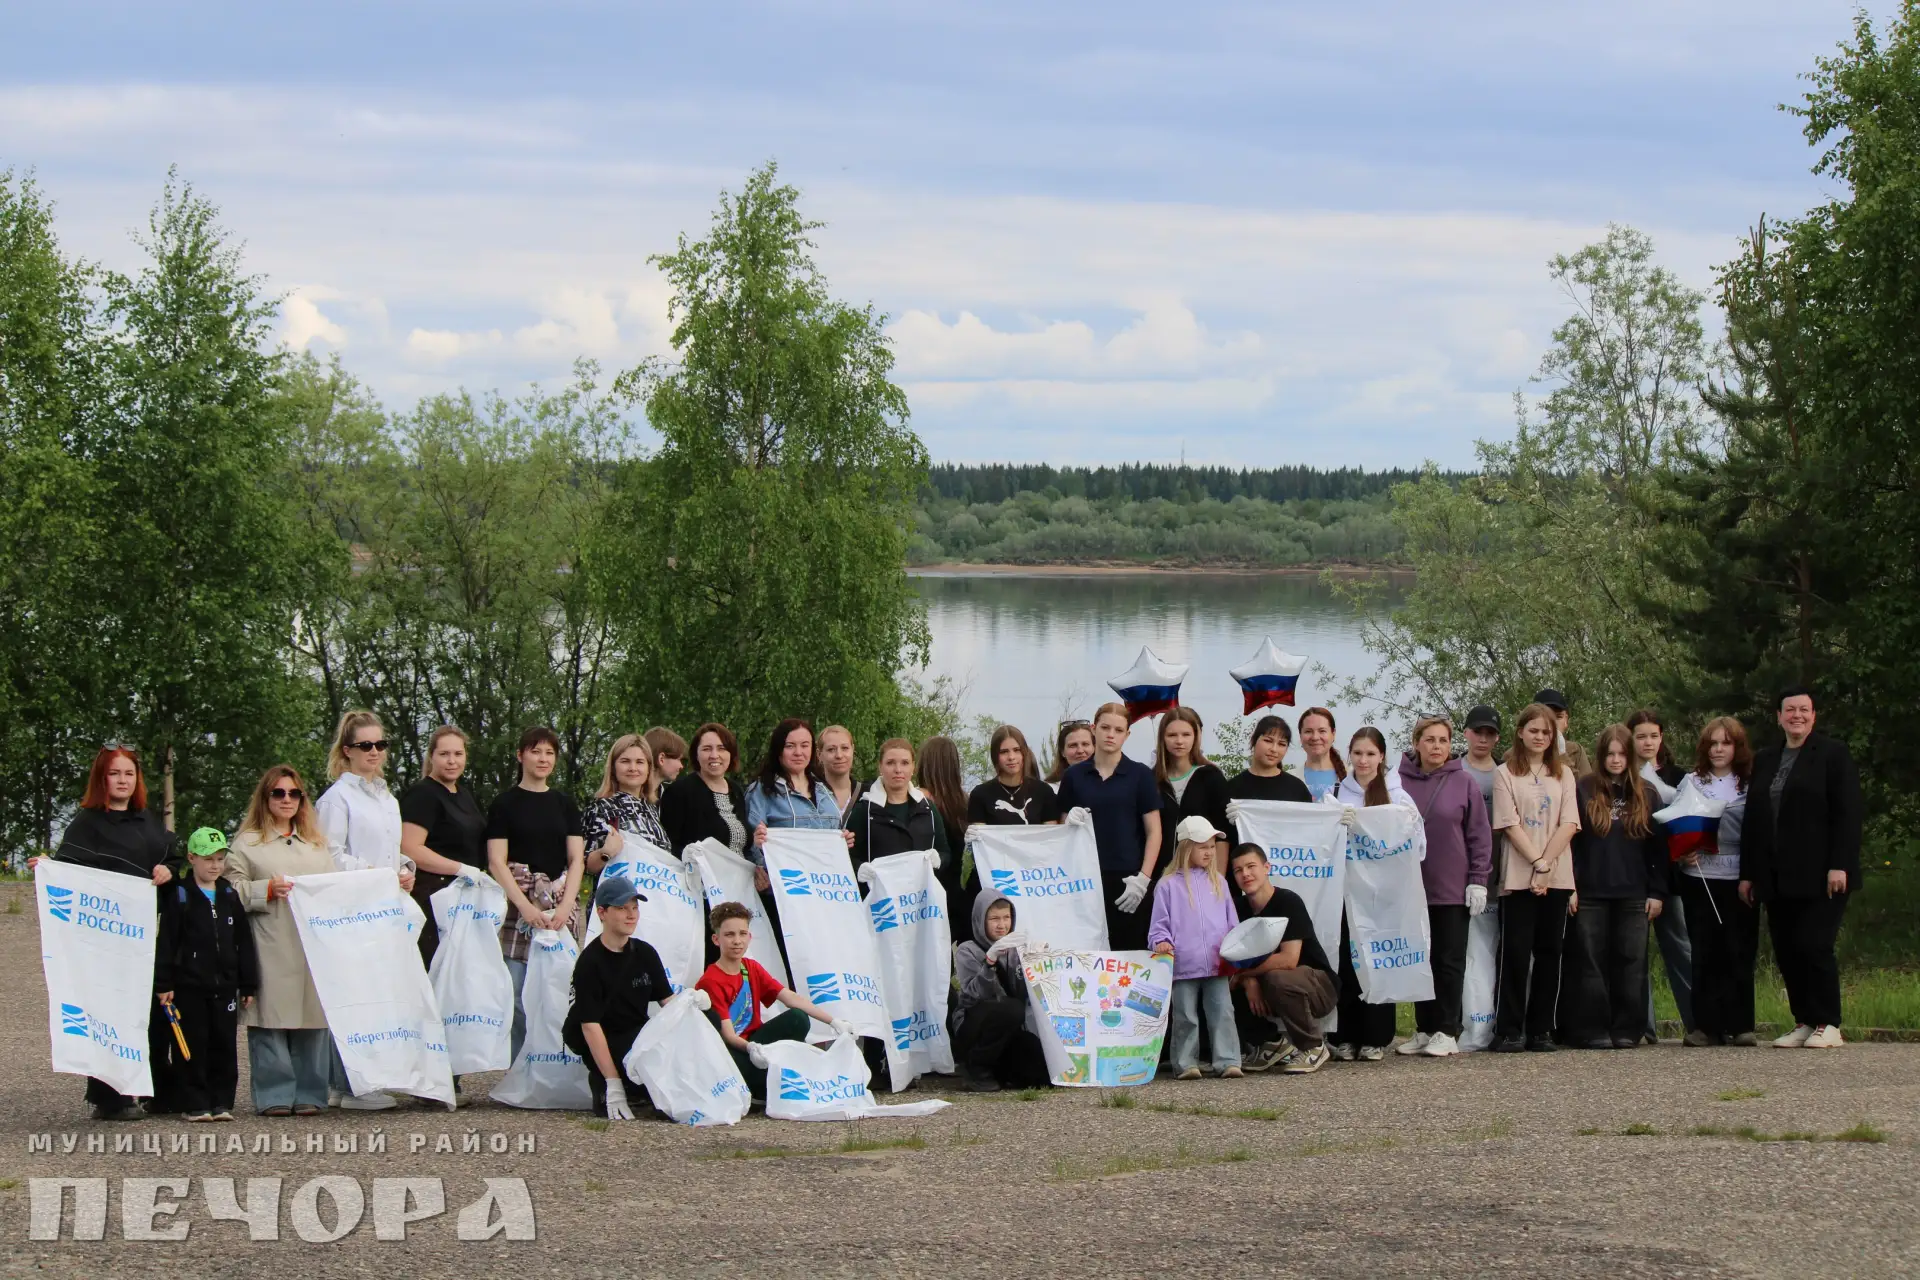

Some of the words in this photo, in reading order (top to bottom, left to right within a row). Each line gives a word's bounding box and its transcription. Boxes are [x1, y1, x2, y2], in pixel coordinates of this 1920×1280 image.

[1269, 847, 1316, 862] ВОДА
[636, 861, 680, 885] ВОДА
[810, 872, 852, 887] ВОДА
[1020, 866, 1068, 882] ВОДА
[634, 877, 697, 909] РОССИИ
[1024, 878, 1095, 897] РОССИИ
[79, 892, 121, 916] ВОДА
[77, 911, 145, 940] РОССИИ
[1370, 937, 1409, 953] ВОДА
[1093, 957, 1151, 981] ЛЕНТА
[1372, 951, 1425, 970] РОССИИ
[842, 972, 878, 990] ВОДА
[92, 1030, 141, 1062] РОСИИ
